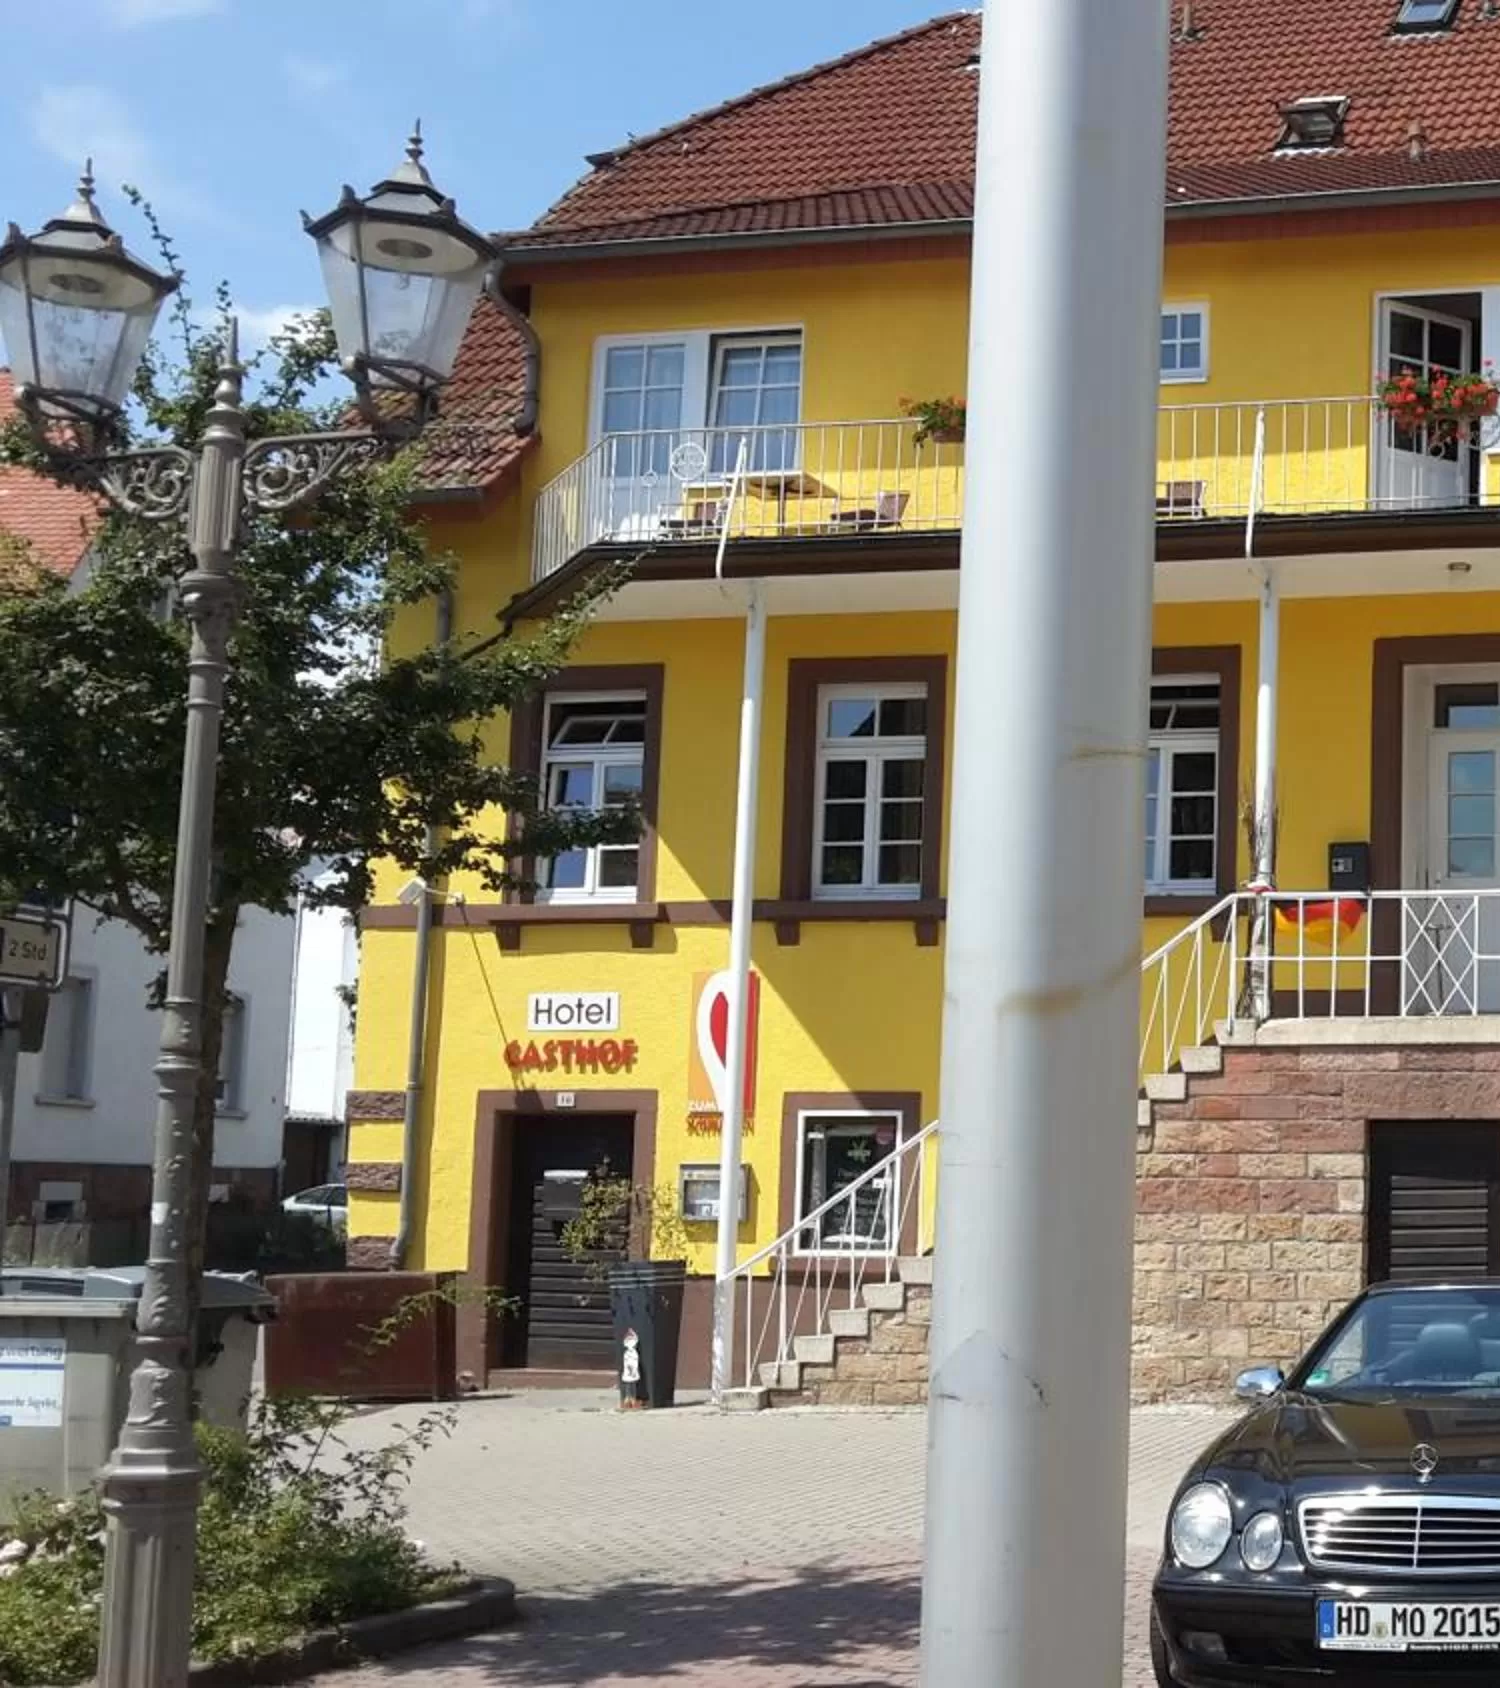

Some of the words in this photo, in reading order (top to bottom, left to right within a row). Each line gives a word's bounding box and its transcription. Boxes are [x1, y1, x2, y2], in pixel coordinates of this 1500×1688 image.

[534, 997, 611, 1025] Hotel
[503, 1038, 639, 1072] GASTHOF
[1336, 1606, 1370, 1636] HD
[1391, 1606, 1426, 1637] MO
[1433, 1606, 1500, 1637] 2015
